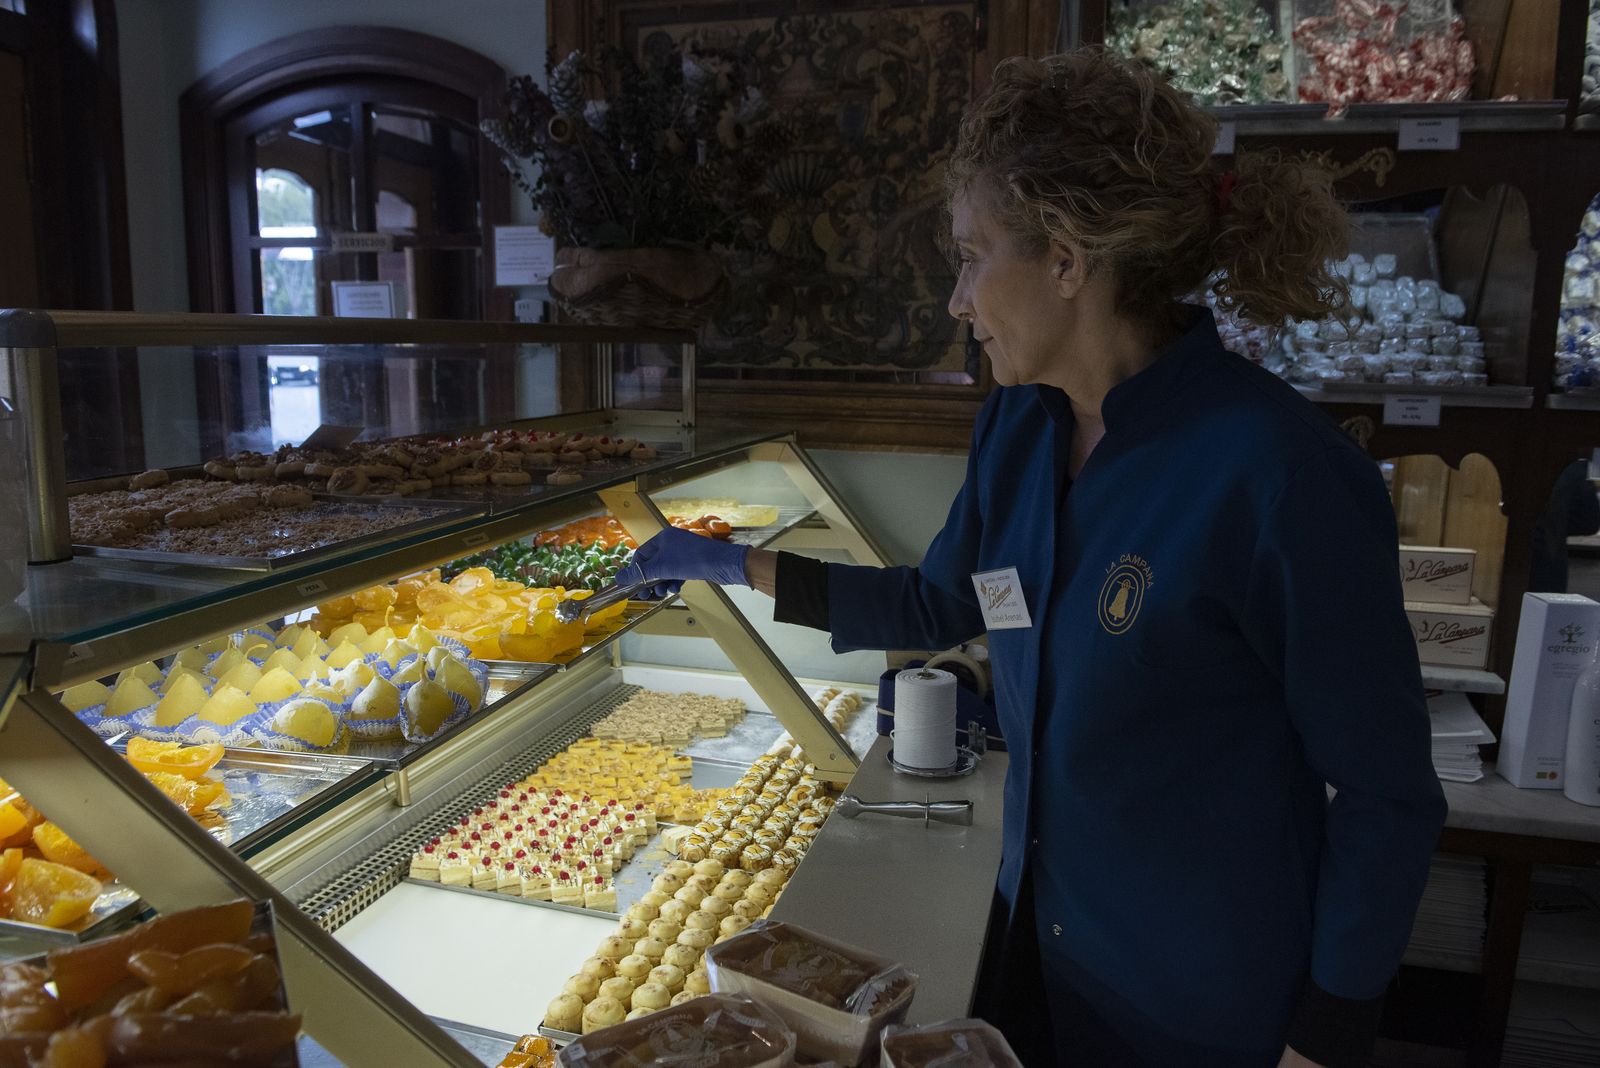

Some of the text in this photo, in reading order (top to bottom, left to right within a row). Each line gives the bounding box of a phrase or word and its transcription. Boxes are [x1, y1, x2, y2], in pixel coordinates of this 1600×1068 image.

[1105, 553, 1155, 589] LA CAMPANA
[1429, 561, 1470, 579] Campana
[1443, 623, 1486, 640] Campana
[1547, 644, 1590, 656] egregio
